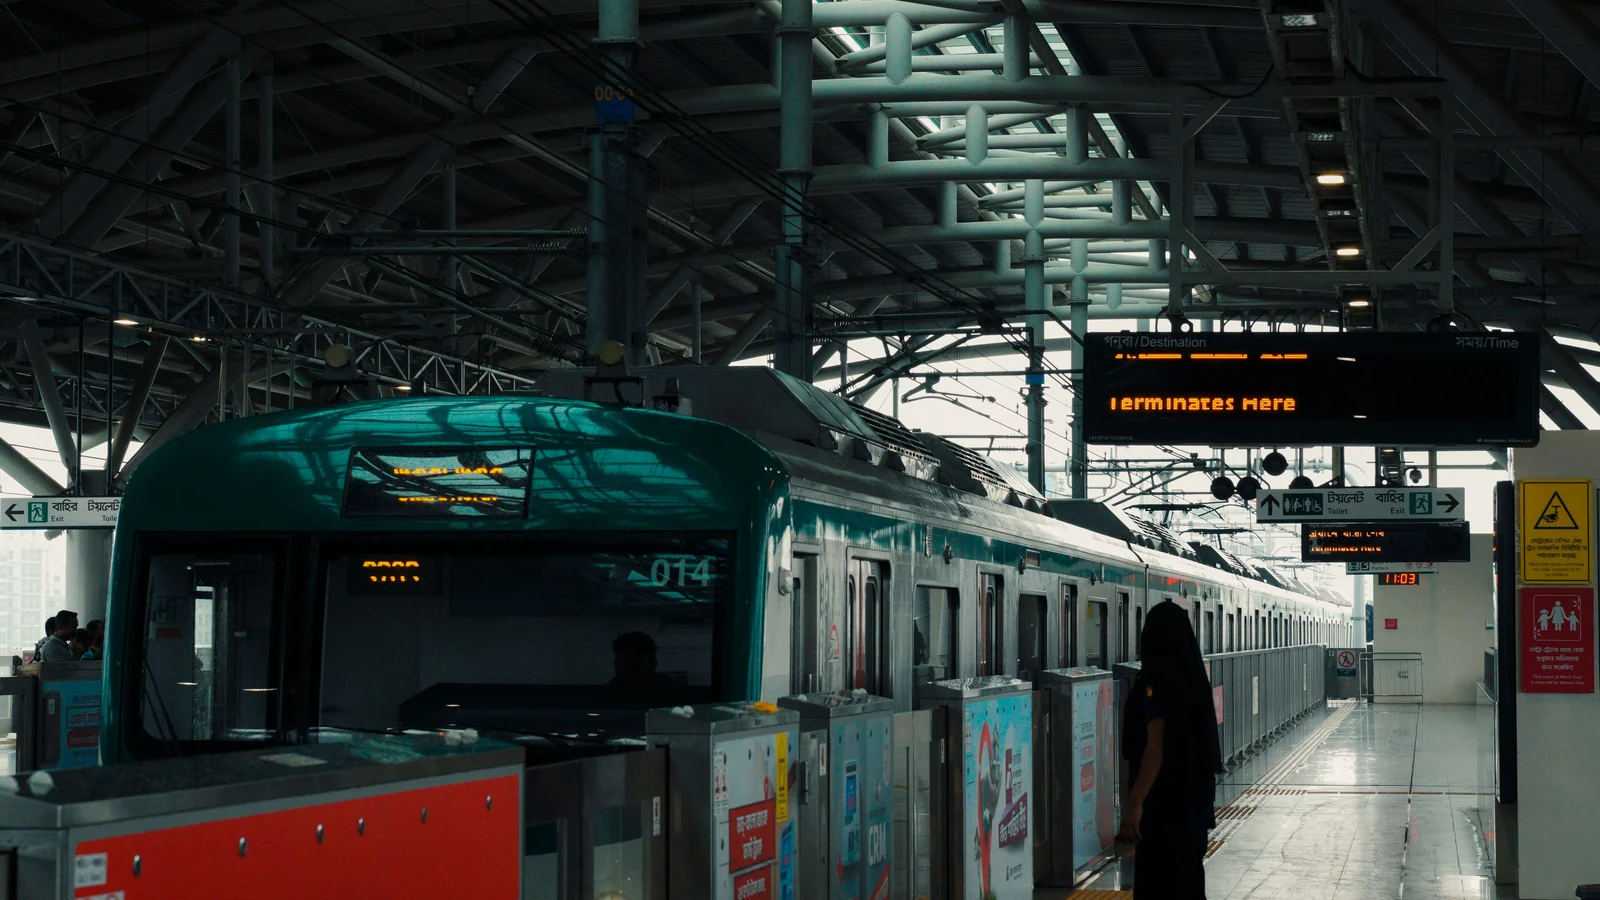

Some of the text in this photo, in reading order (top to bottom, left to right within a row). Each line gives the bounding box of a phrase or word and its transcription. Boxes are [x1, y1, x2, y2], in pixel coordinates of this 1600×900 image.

[1327, 491, 1364, 504] টয়লেট
[1374, 490, 1405, 504] বাহির
[52, 499, 78, 512] বাহির
[650, 558, 709, 587] 014
[1385, 573, 1416, 584] 11:03
